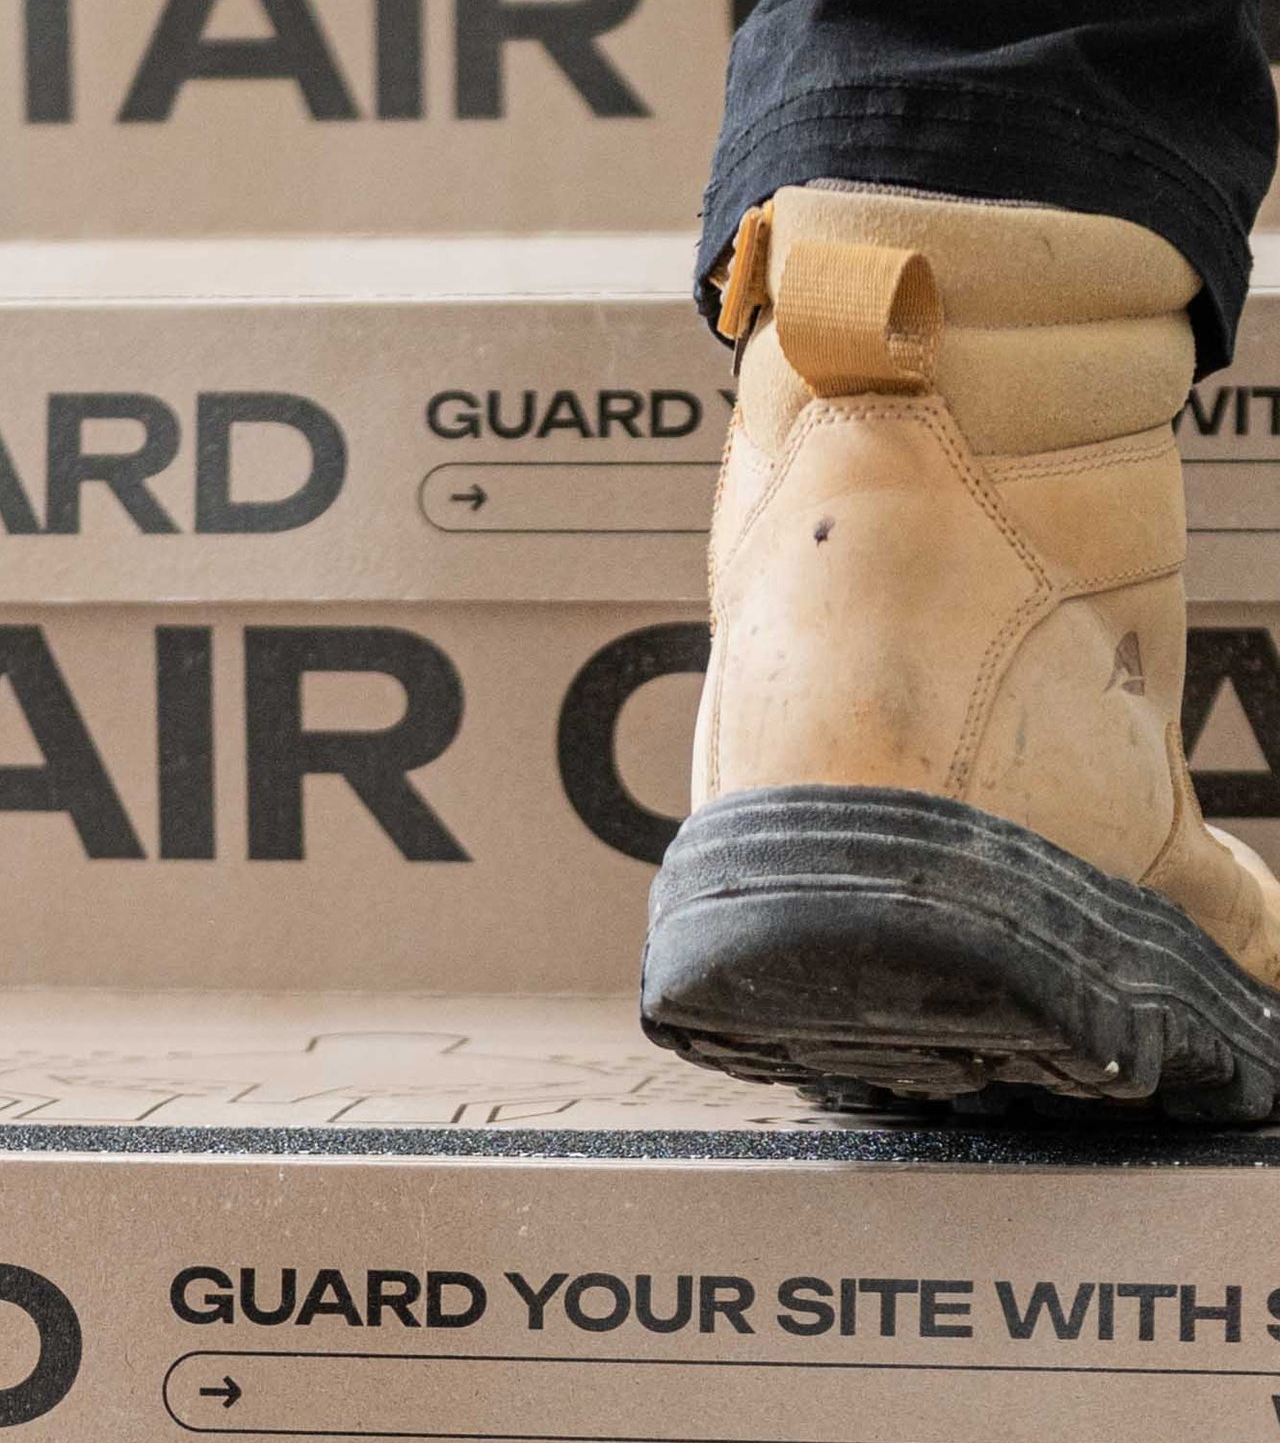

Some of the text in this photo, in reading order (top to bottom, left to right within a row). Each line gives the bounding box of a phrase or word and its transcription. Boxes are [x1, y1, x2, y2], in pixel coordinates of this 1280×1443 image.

[427, 390, 702, 439] GUARD
[170, 1267, 486, 1328] GUARD
[504, 1272, 755, 1334] YOUR
[777, 1277, 973, 1338] SITE
[995, 1281, 1241, 1343] WITH
